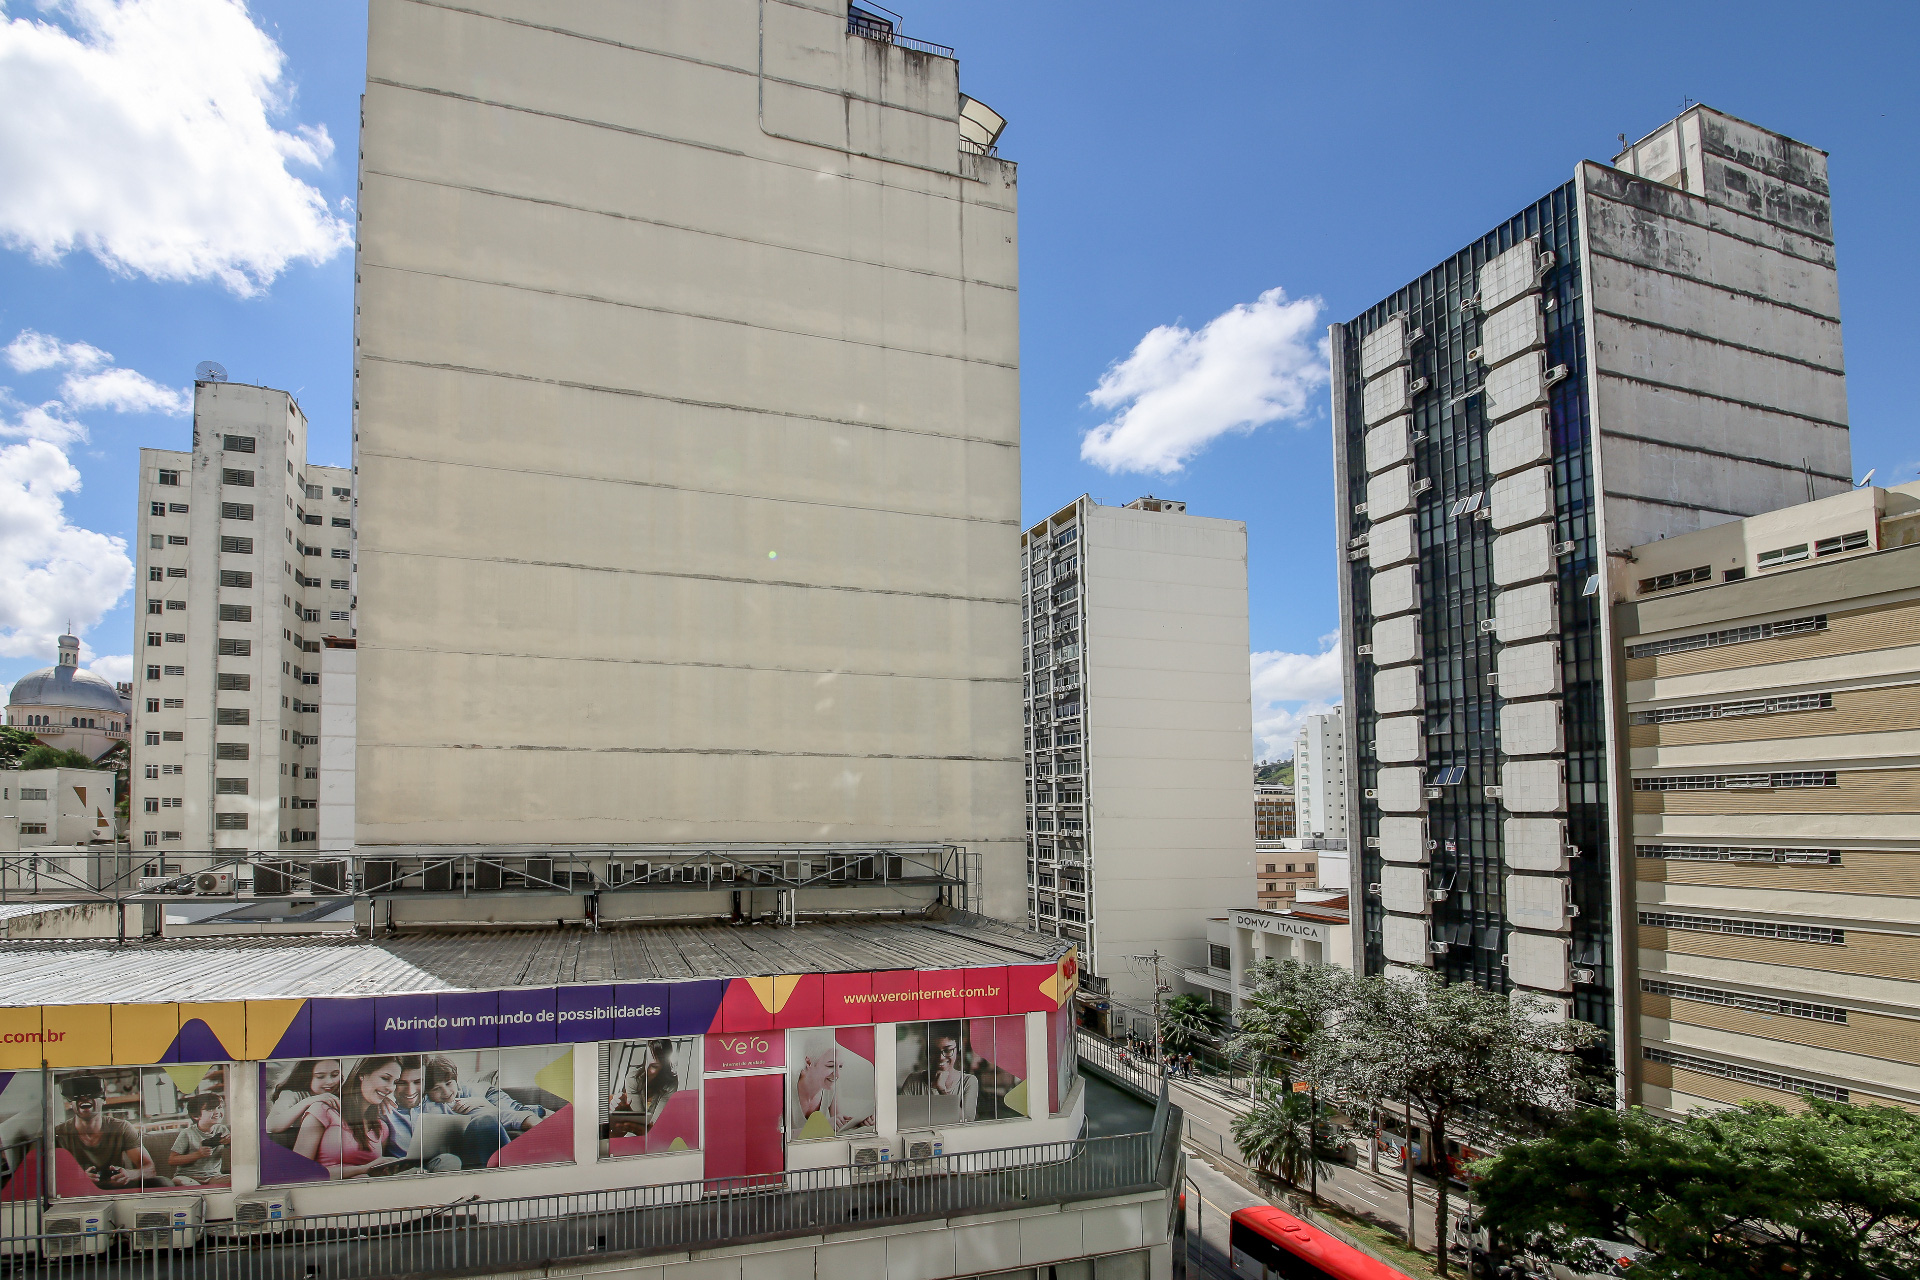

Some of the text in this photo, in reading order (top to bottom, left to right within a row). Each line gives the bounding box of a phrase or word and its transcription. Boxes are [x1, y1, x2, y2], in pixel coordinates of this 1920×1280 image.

[1277, 922, 1318, 937] ITALICA
[843, 984, 1001, 1004] www.verointernet.com.br
[384, 1004, 661, 1031] Abrindo um mundo de possibilidades
